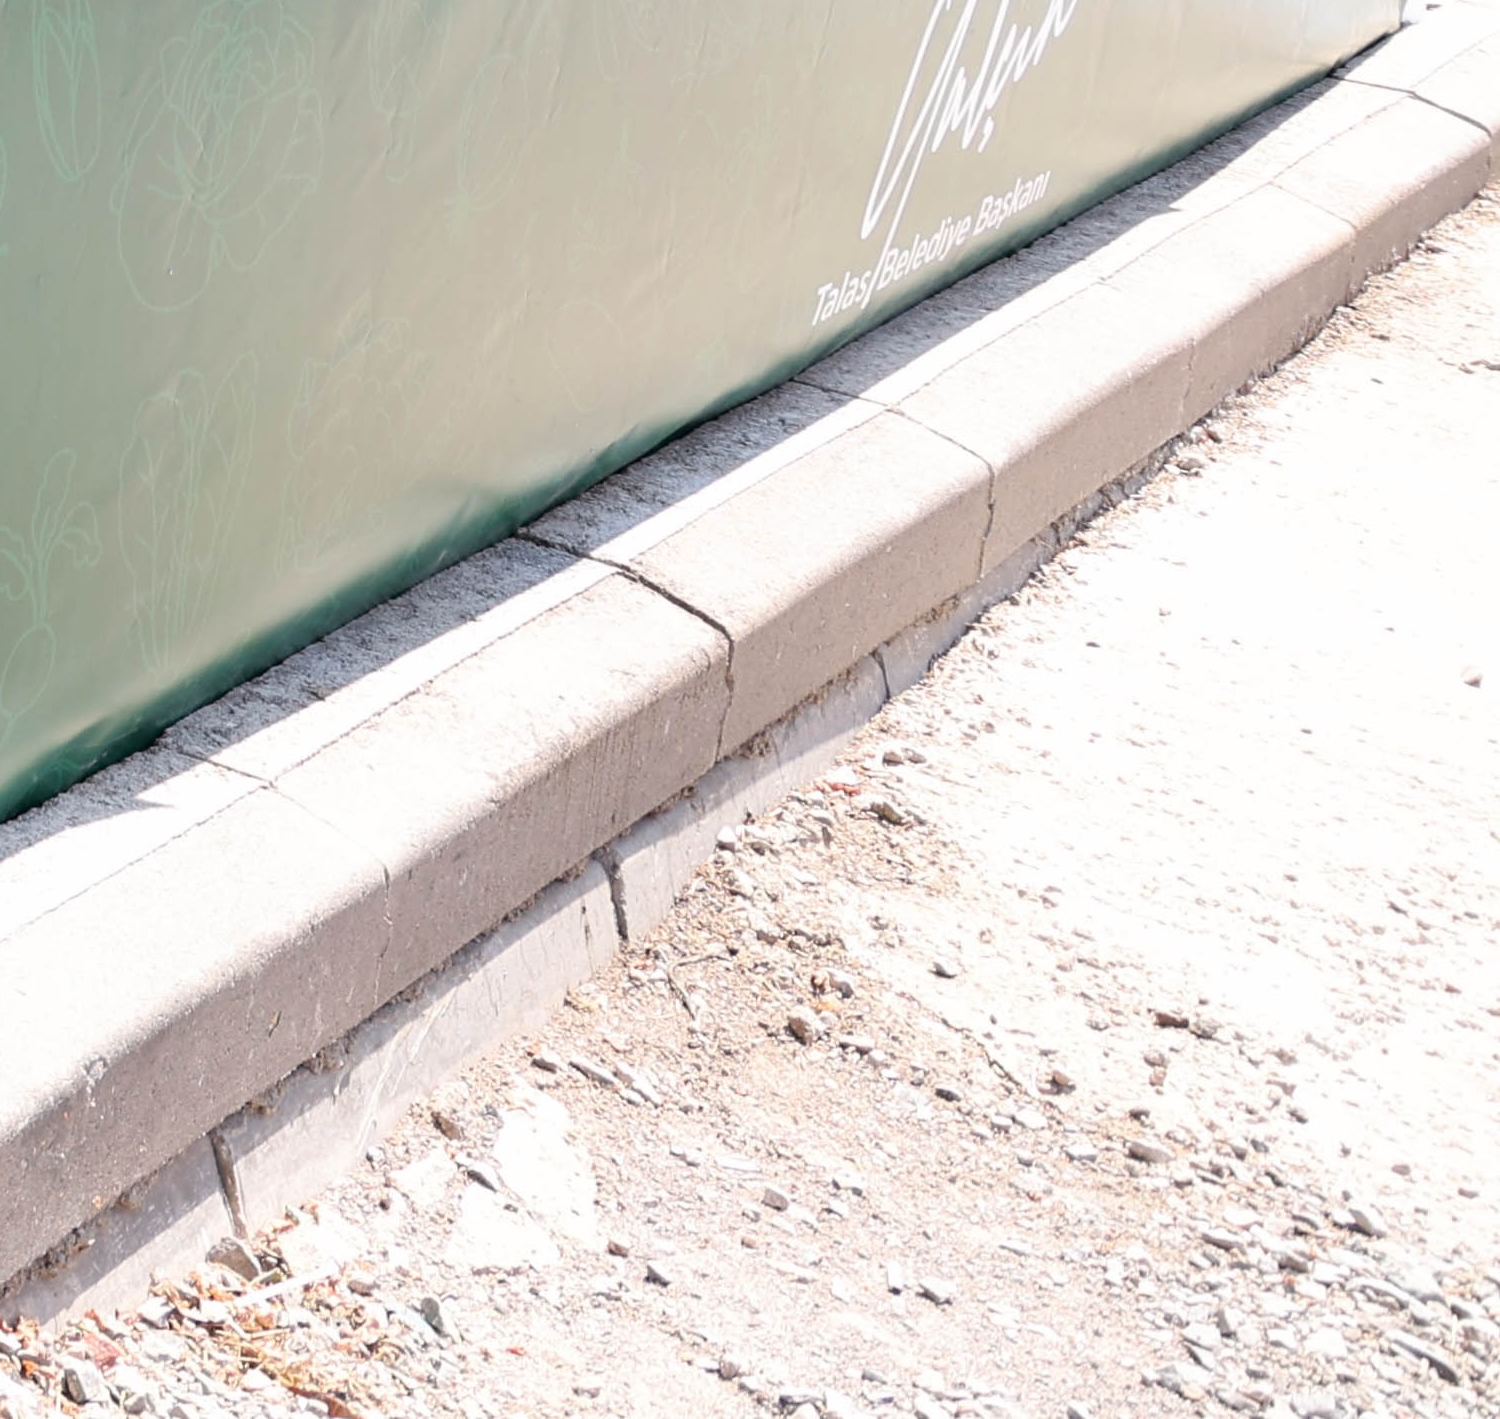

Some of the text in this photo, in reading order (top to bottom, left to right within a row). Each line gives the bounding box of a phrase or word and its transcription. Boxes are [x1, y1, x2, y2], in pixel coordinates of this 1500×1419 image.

[811, 170, 1051, 326] Talas Belediye Başkanı
